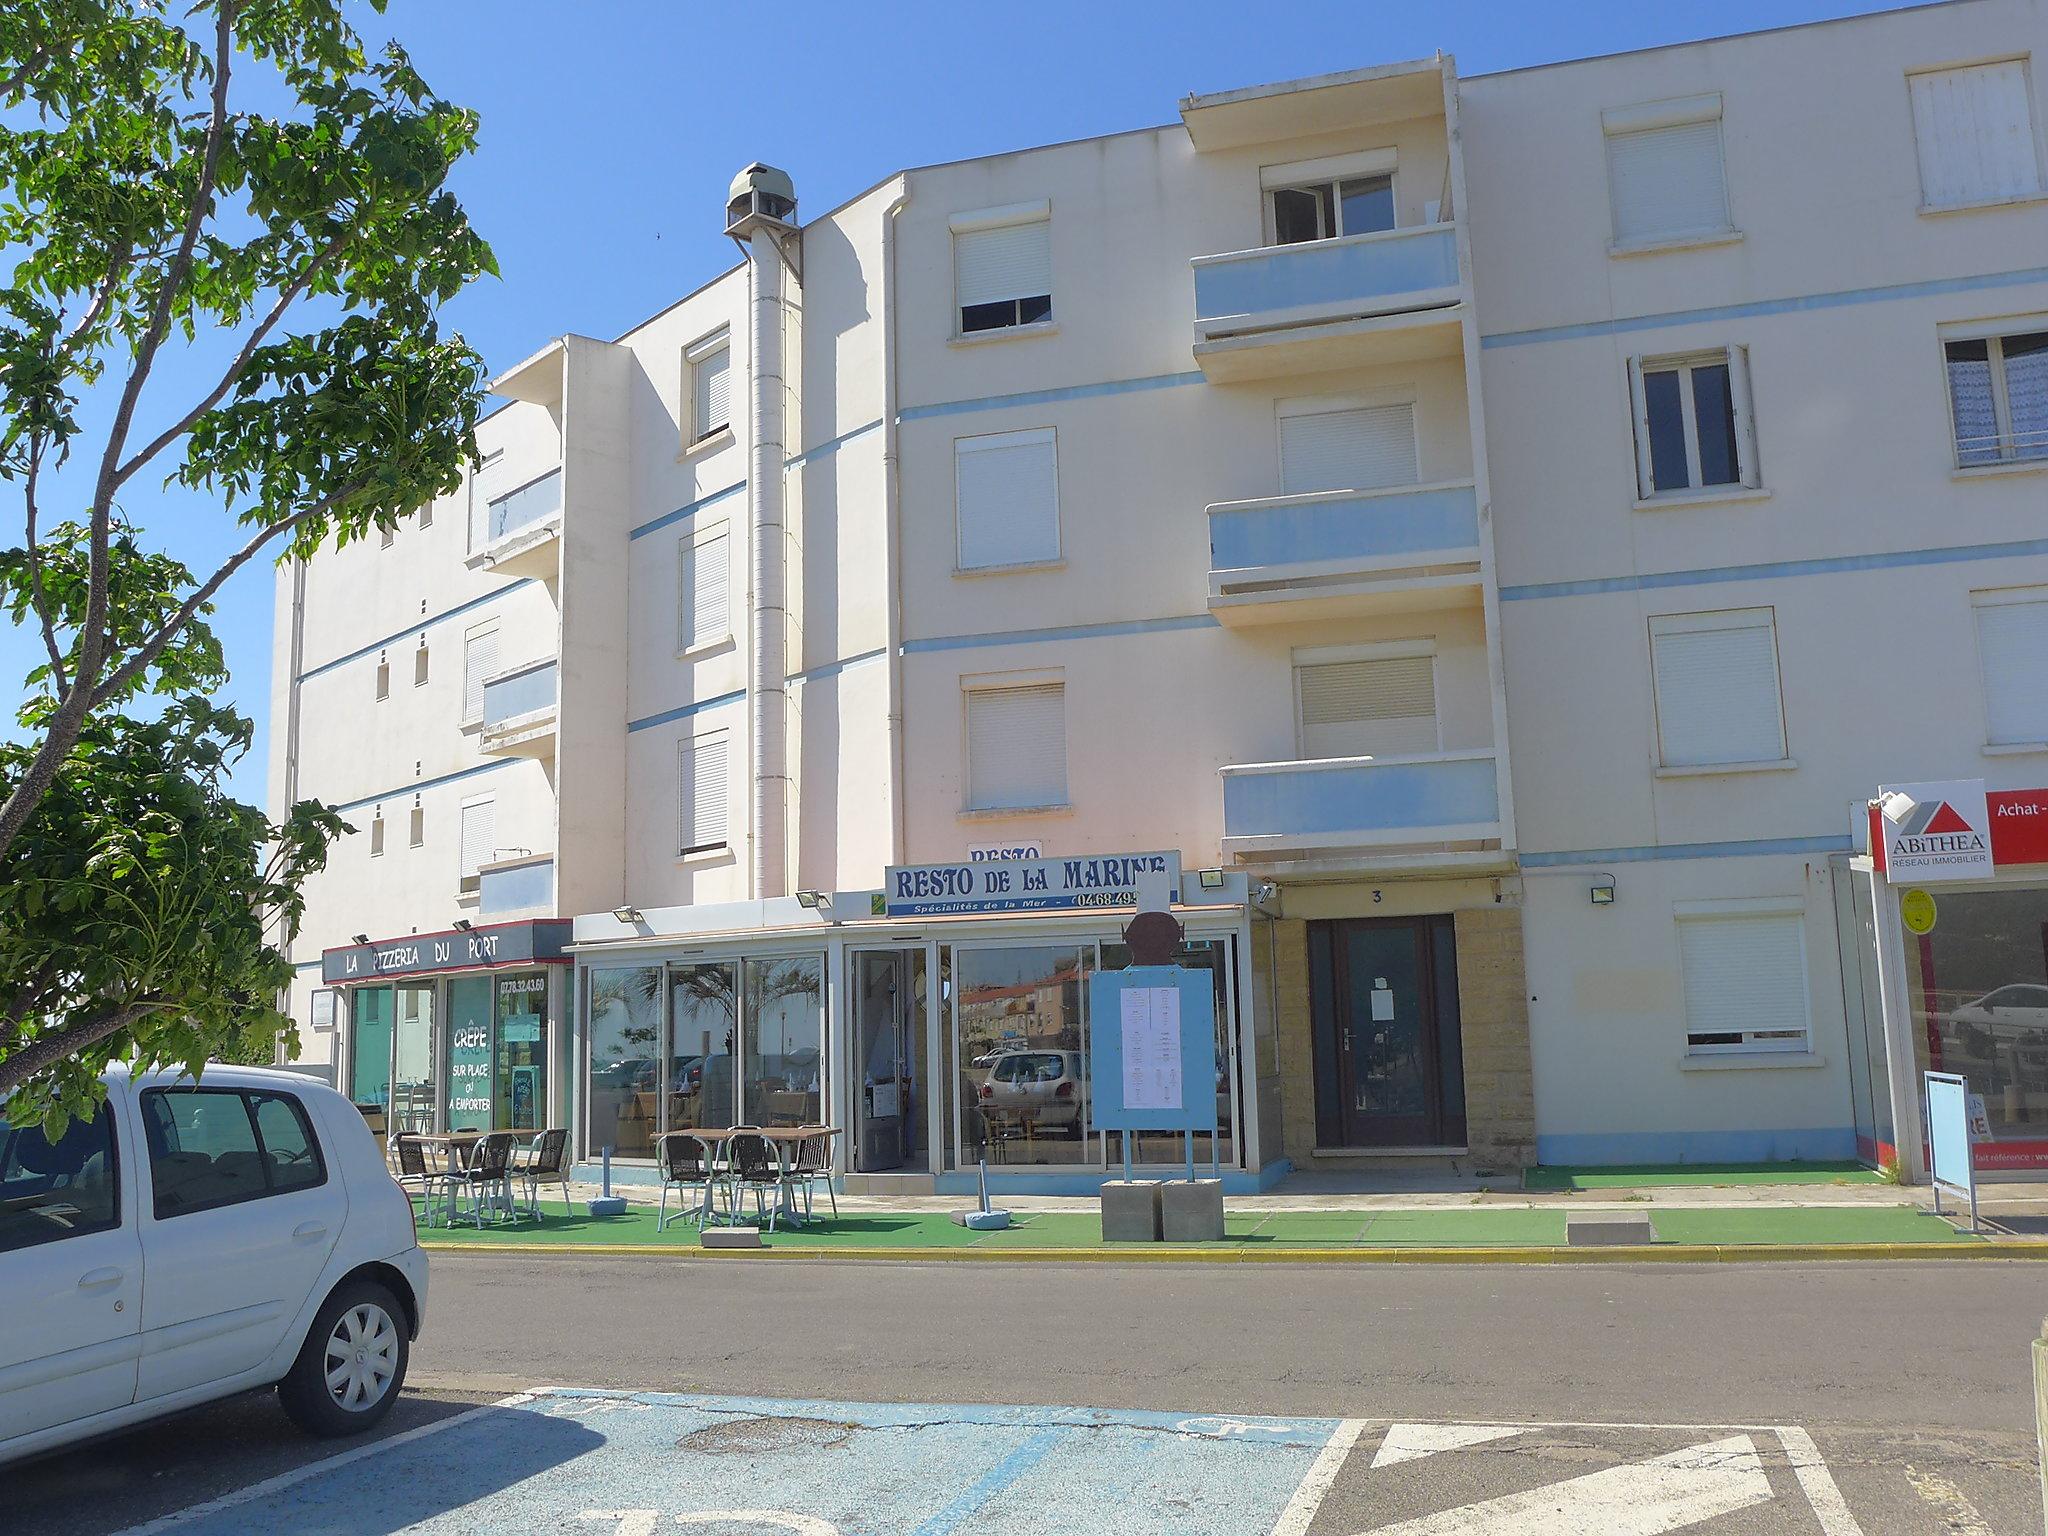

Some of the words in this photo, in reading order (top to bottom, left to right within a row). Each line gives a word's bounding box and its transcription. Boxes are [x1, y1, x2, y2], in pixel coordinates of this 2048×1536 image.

[1997, 803, 2039, 817] Achat
[1892, 856, 1929, 868] RÉSEAU
[1932, 854, 1986, 865] IMMOBILIER
[896, 867, 973, 898] RESTO
[984, 870, 1010, 893] DE
[1022, 867, 1048, 891] LA
[1372, 890, 1382, 903] 3
[914, 902, 978, 914] Spécialités
[984, 902, 998, 910] de
[1004, 901, 1015, 909] la
[1022, 900, 1046, 908] Mer
[346, 955, 358, 974] LA
[373, 946, 419, 970] PIZZERIA
[434, 942, 450, 963] DU
[468, 935, 499, 959] PORT
[454, 1019, 487, 1048] CRÊPE
[452, 1064, 466, 1077] SUR
[467, 1063, 488, 1077] PLACE
[456, 1097, 491, 1111] EMPORTER
